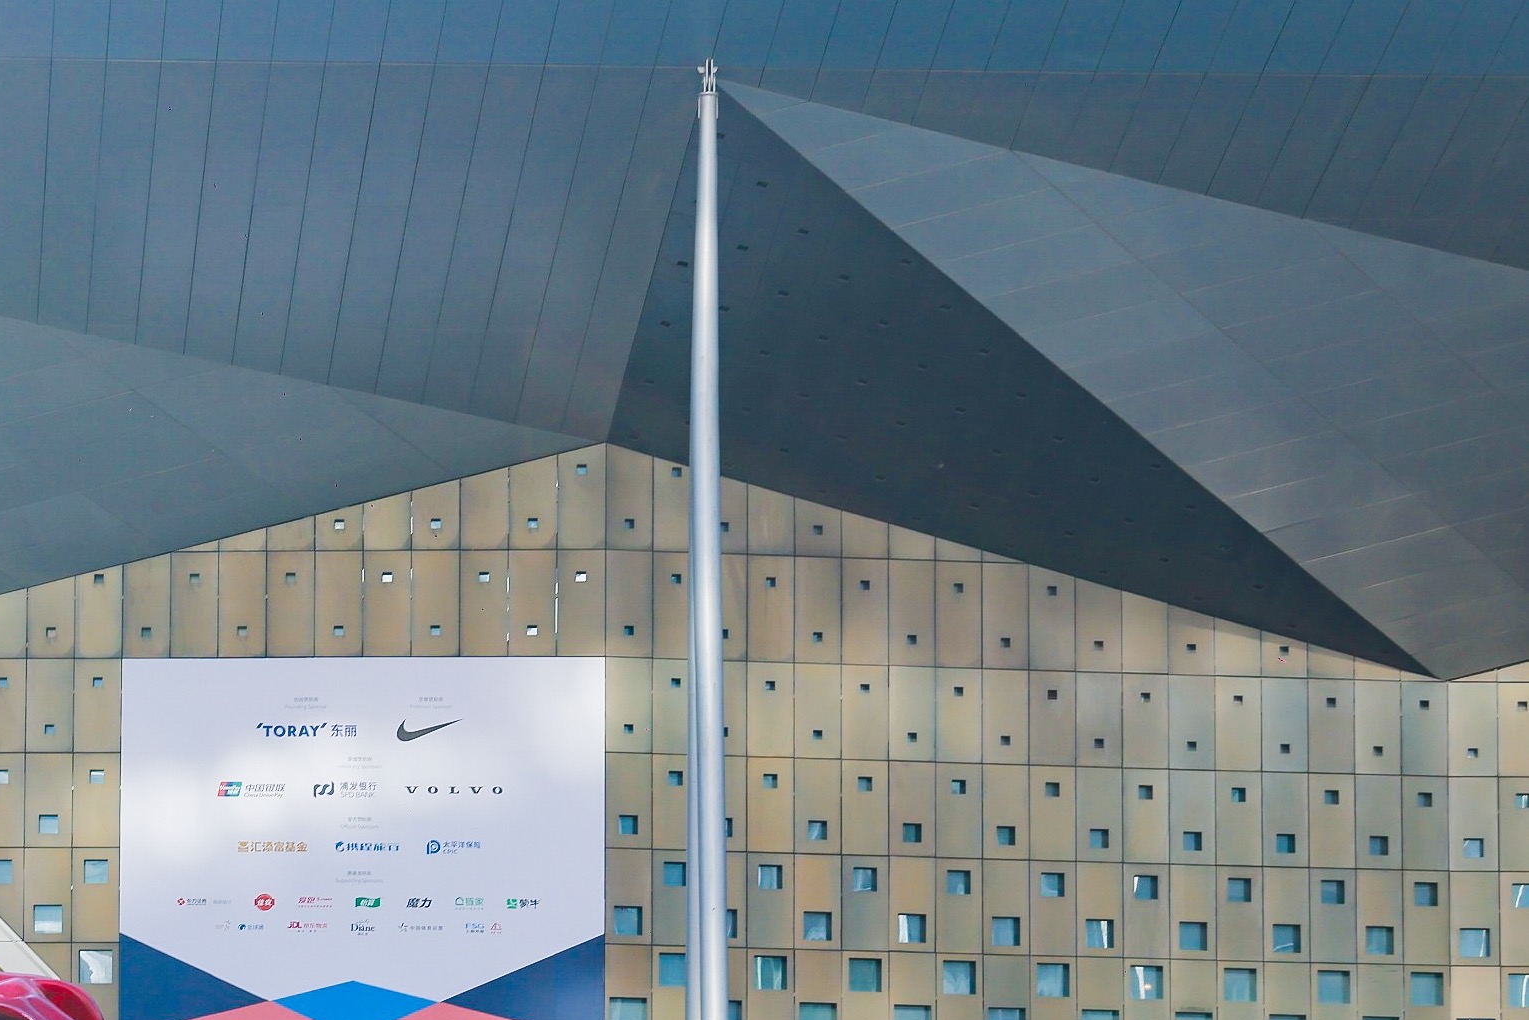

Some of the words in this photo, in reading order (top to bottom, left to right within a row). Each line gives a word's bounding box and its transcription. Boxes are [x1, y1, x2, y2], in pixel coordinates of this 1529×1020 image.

[331, 724, 358, 737] 东丽
[339, 782, 378, 792] 浦发银行
[442, 841, 481, 849] 太平洋保险
[406, 897, 432, 908] 魔力
